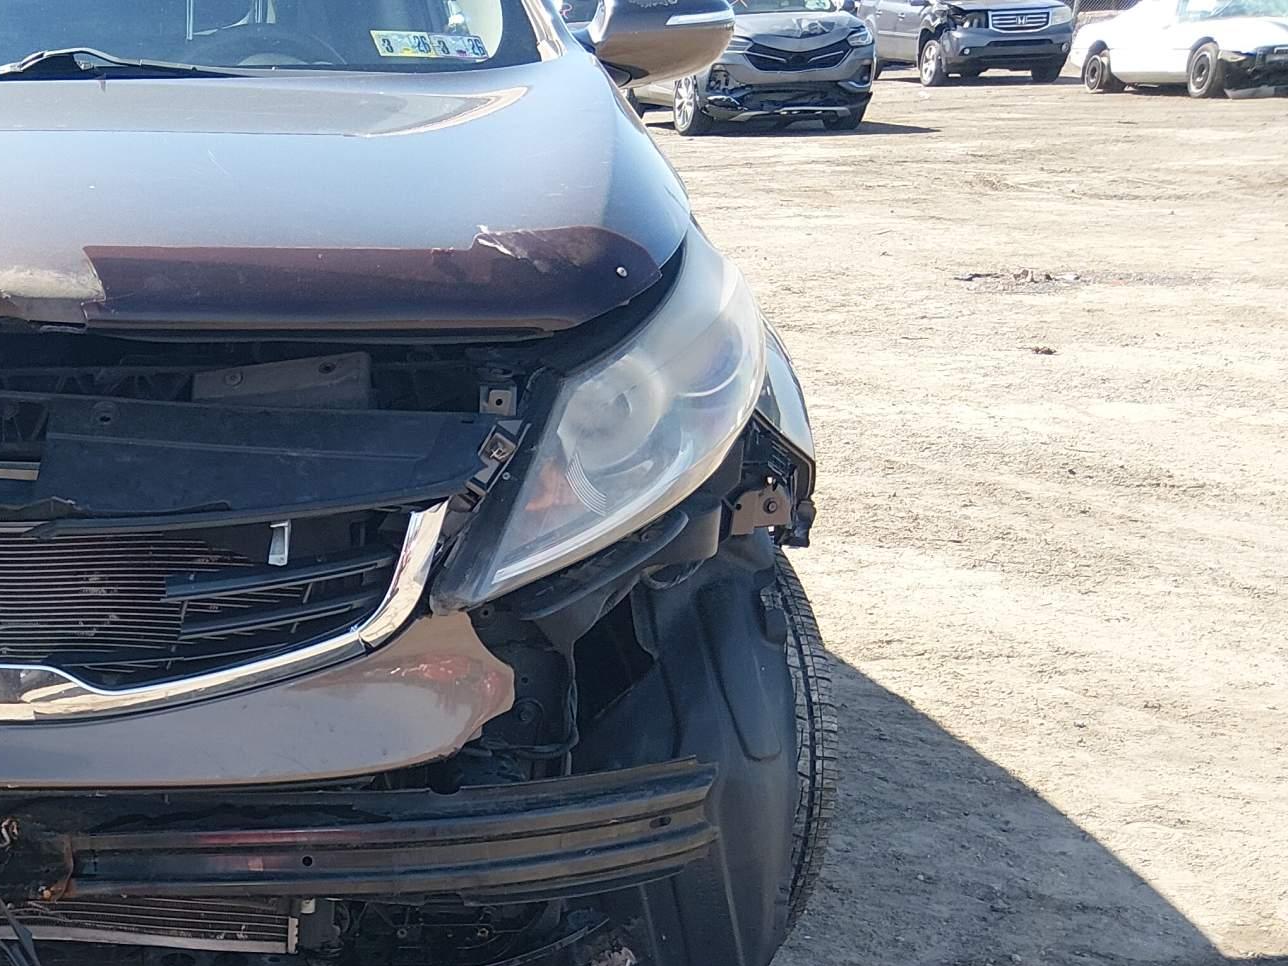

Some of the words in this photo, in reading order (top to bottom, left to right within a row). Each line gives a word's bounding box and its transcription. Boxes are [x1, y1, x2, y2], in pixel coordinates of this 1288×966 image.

[382, 38, 394, 53] 3
[413, 35, 432, 54] 26
[467, 38, 486, 56] 26
